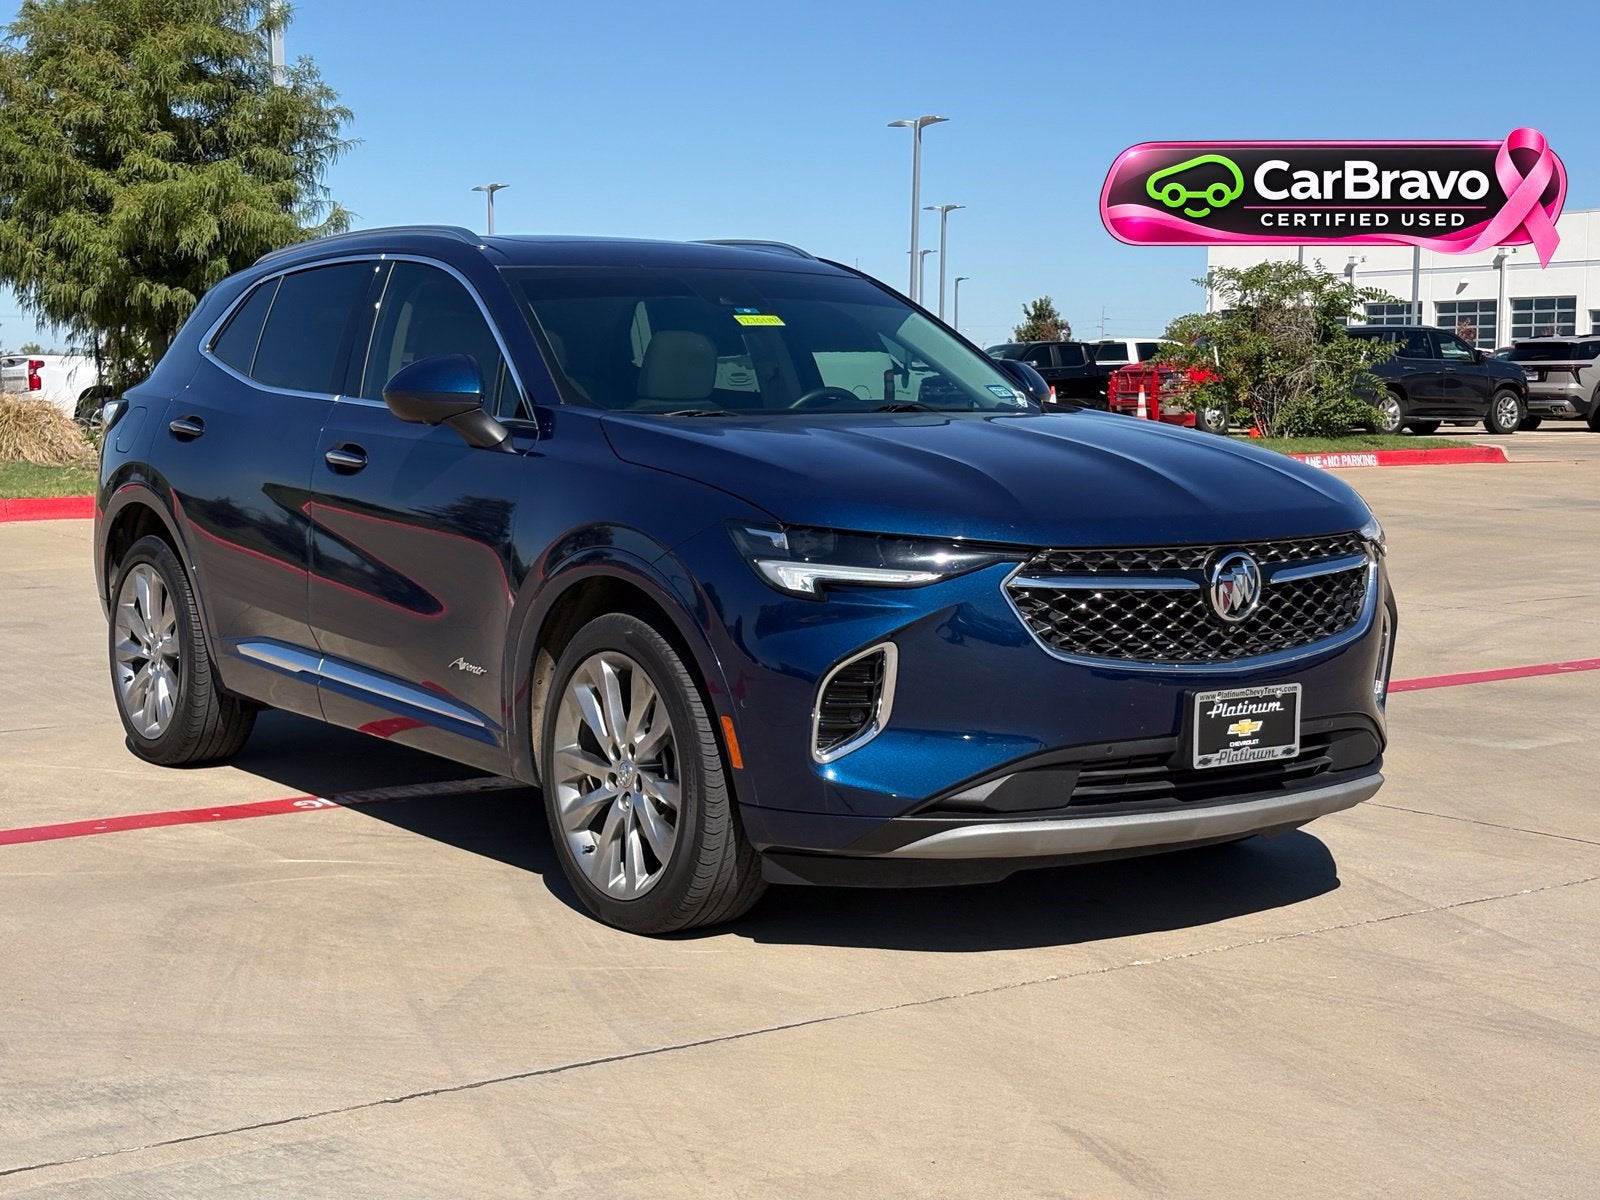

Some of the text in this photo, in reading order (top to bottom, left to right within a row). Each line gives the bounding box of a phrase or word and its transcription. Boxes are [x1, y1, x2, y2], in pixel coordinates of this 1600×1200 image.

[1327, 455, 1340, 467] NO
[1341, 454, 1377, 467] PARKING
[1199, 685, 1298, 701] wwwPlatinumChevyTexas.com
[1206, 701, 1284, 718] Platinum
[1229, 738, 1260, 748] CHEVROLET
[1214, 747, 1280, 764] Platinum
